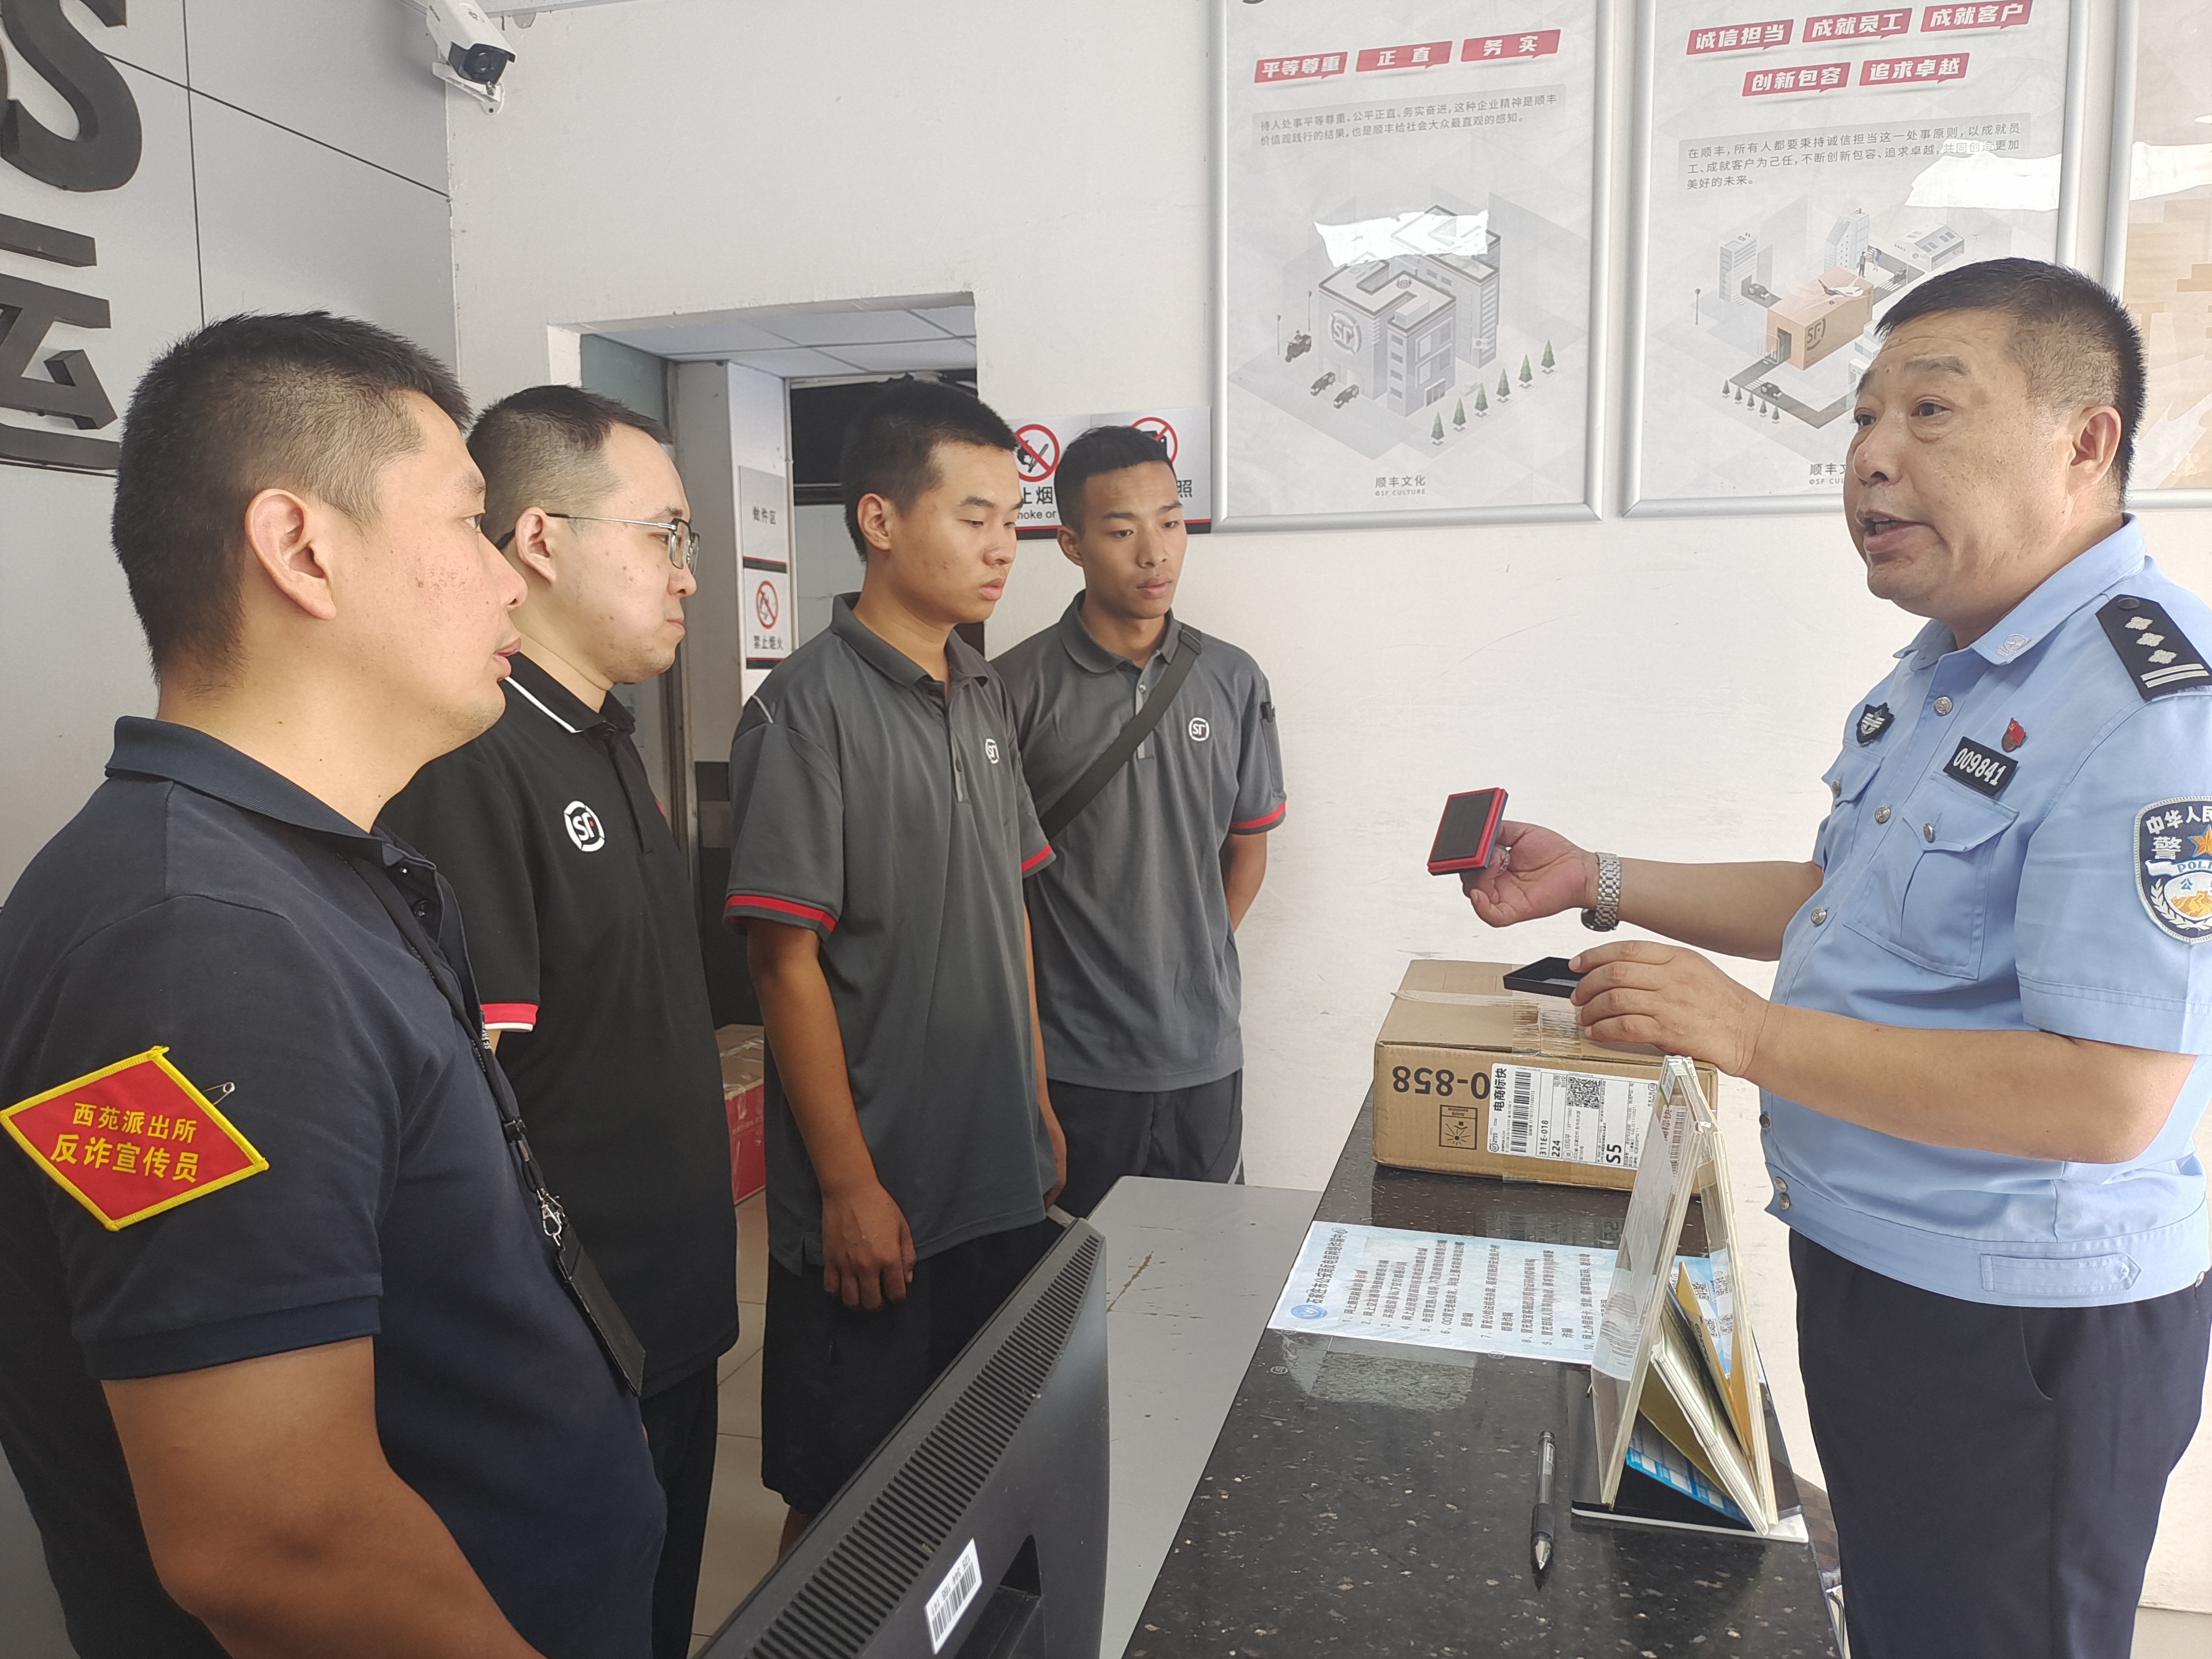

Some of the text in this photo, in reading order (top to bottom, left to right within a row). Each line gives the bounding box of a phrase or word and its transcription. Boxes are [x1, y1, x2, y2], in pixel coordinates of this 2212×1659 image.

[1812, 13, 1904, 38] 成就员工
[1931, 2, 2024, 28] 成就客户
[1695, 24, 1786, 49] 诚信担当
[1262, 55, 1341, 78] 平等尊重
[1751, 66, 1841, 91] 创新包容
[1870, 57, 1960, 82] 追求卓越
[1375, 475, 1425, 488] 顺丰文化
[1953, 747, 2007, 787] 009841
[2151, 837, 2182, 860] 警
[1494, 1068, 1507, 1112] 电商标快
[72, 1102, 197, 1144] 西苑派出所
[1538, 1119, 1548, 1156] 311E-018
[1552, 1139, 1561, 1157] 224
[50, 1133, 199, 1183] 反诈宣传员
[1605, 1143, 1621, 1164] S5
